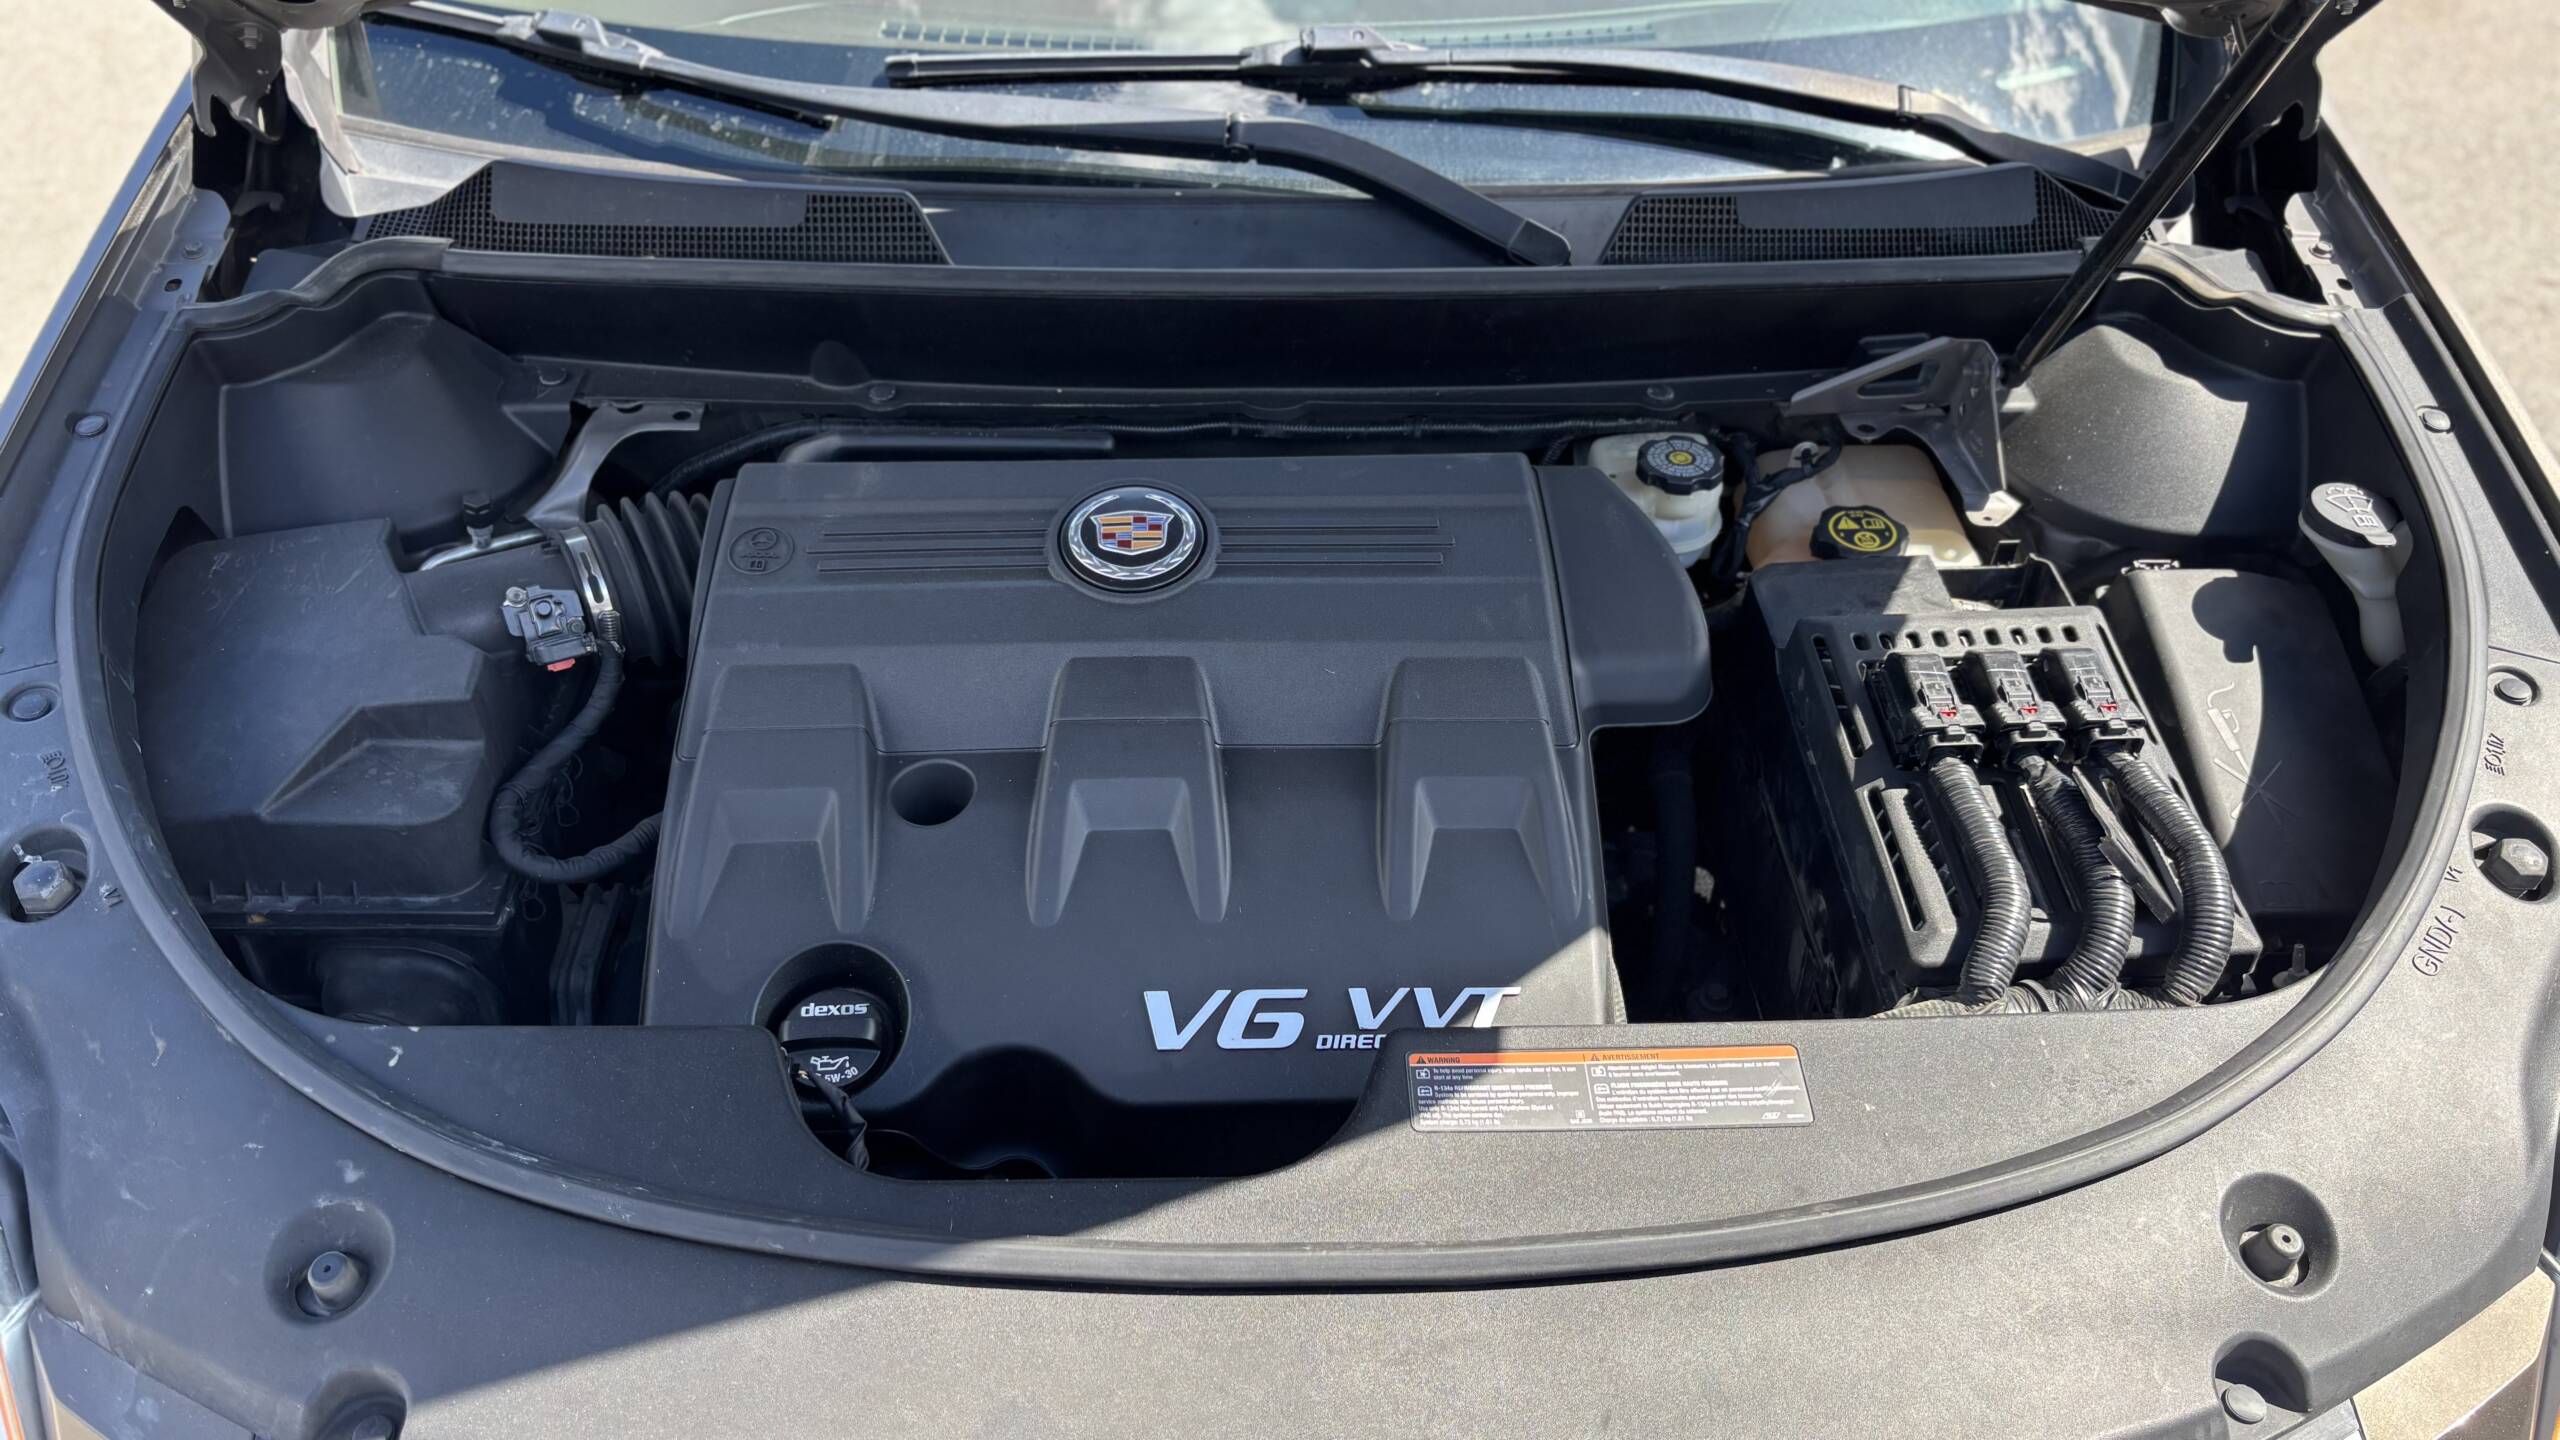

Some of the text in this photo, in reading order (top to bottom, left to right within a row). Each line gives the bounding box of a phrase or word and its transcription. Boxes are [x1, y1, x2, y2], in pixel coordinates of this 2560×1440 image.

[800, 1003, 870, 1017] dexos
[1143, 986, 1521, 1051] V6 VVT
[1427, 1056, 1461, 1064] WARNING
[1602, 1053, 1659, 1061] AVERTISSEMENT
